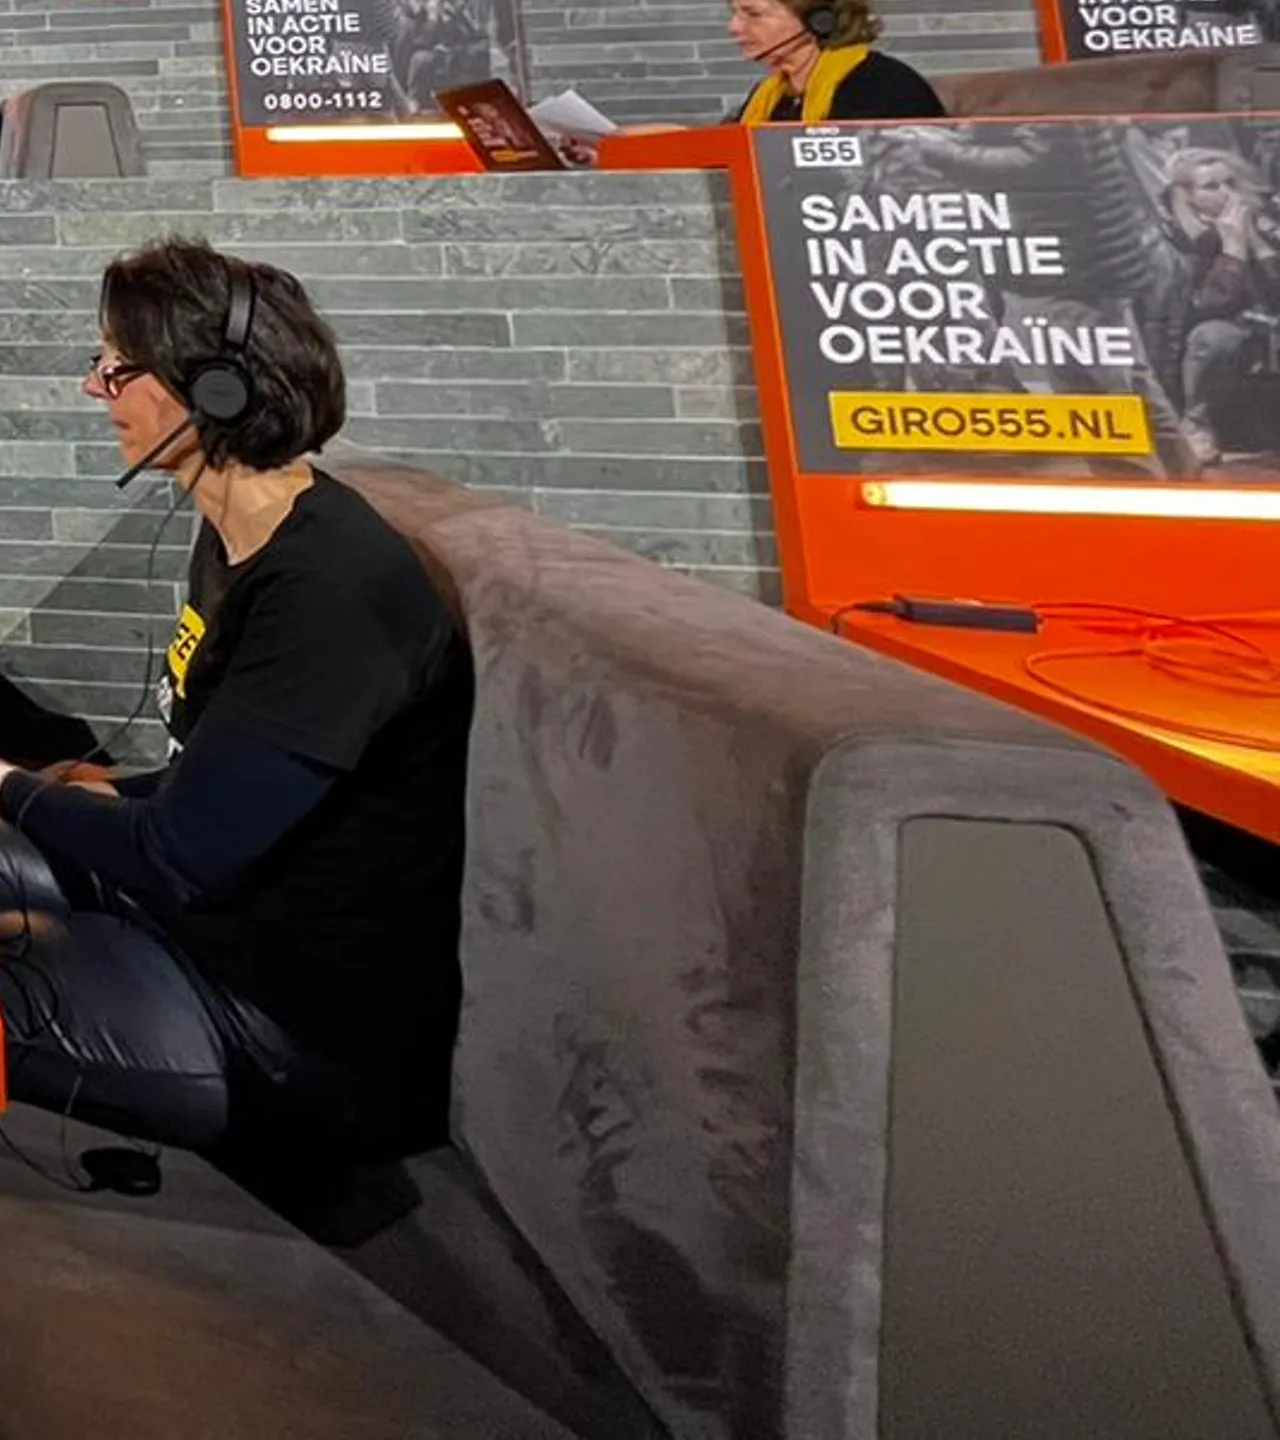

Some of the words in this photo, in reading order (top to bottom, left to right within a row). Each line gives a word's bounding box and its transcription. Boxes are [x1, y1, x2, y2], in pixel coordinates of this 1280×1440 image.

[247, 16, 274, 35] IN
[282, 13, 360, 33] ACTIE
[1078, 5, 1177, 27] VOOR
[248, 35, 327, 55] VOOR
[1085, 21, 1261, 51] OEKRAÏNE
[250, 50, 388, 76] OEKRAÏNE
[264, 91, 382, 110] 0800-1112
[799, 141, 856, 163] 555
[800, 193, 1012, 233] SAMEN
[806, 238, 867, 275] IN
[886, 237, 1065, 275] ACTIE
[810, 281, 988, 320] VOOR
[819, 317, 1135, 366] OEKRAÏNE
[851, 406, 1133, 441] GIRO555.NL
